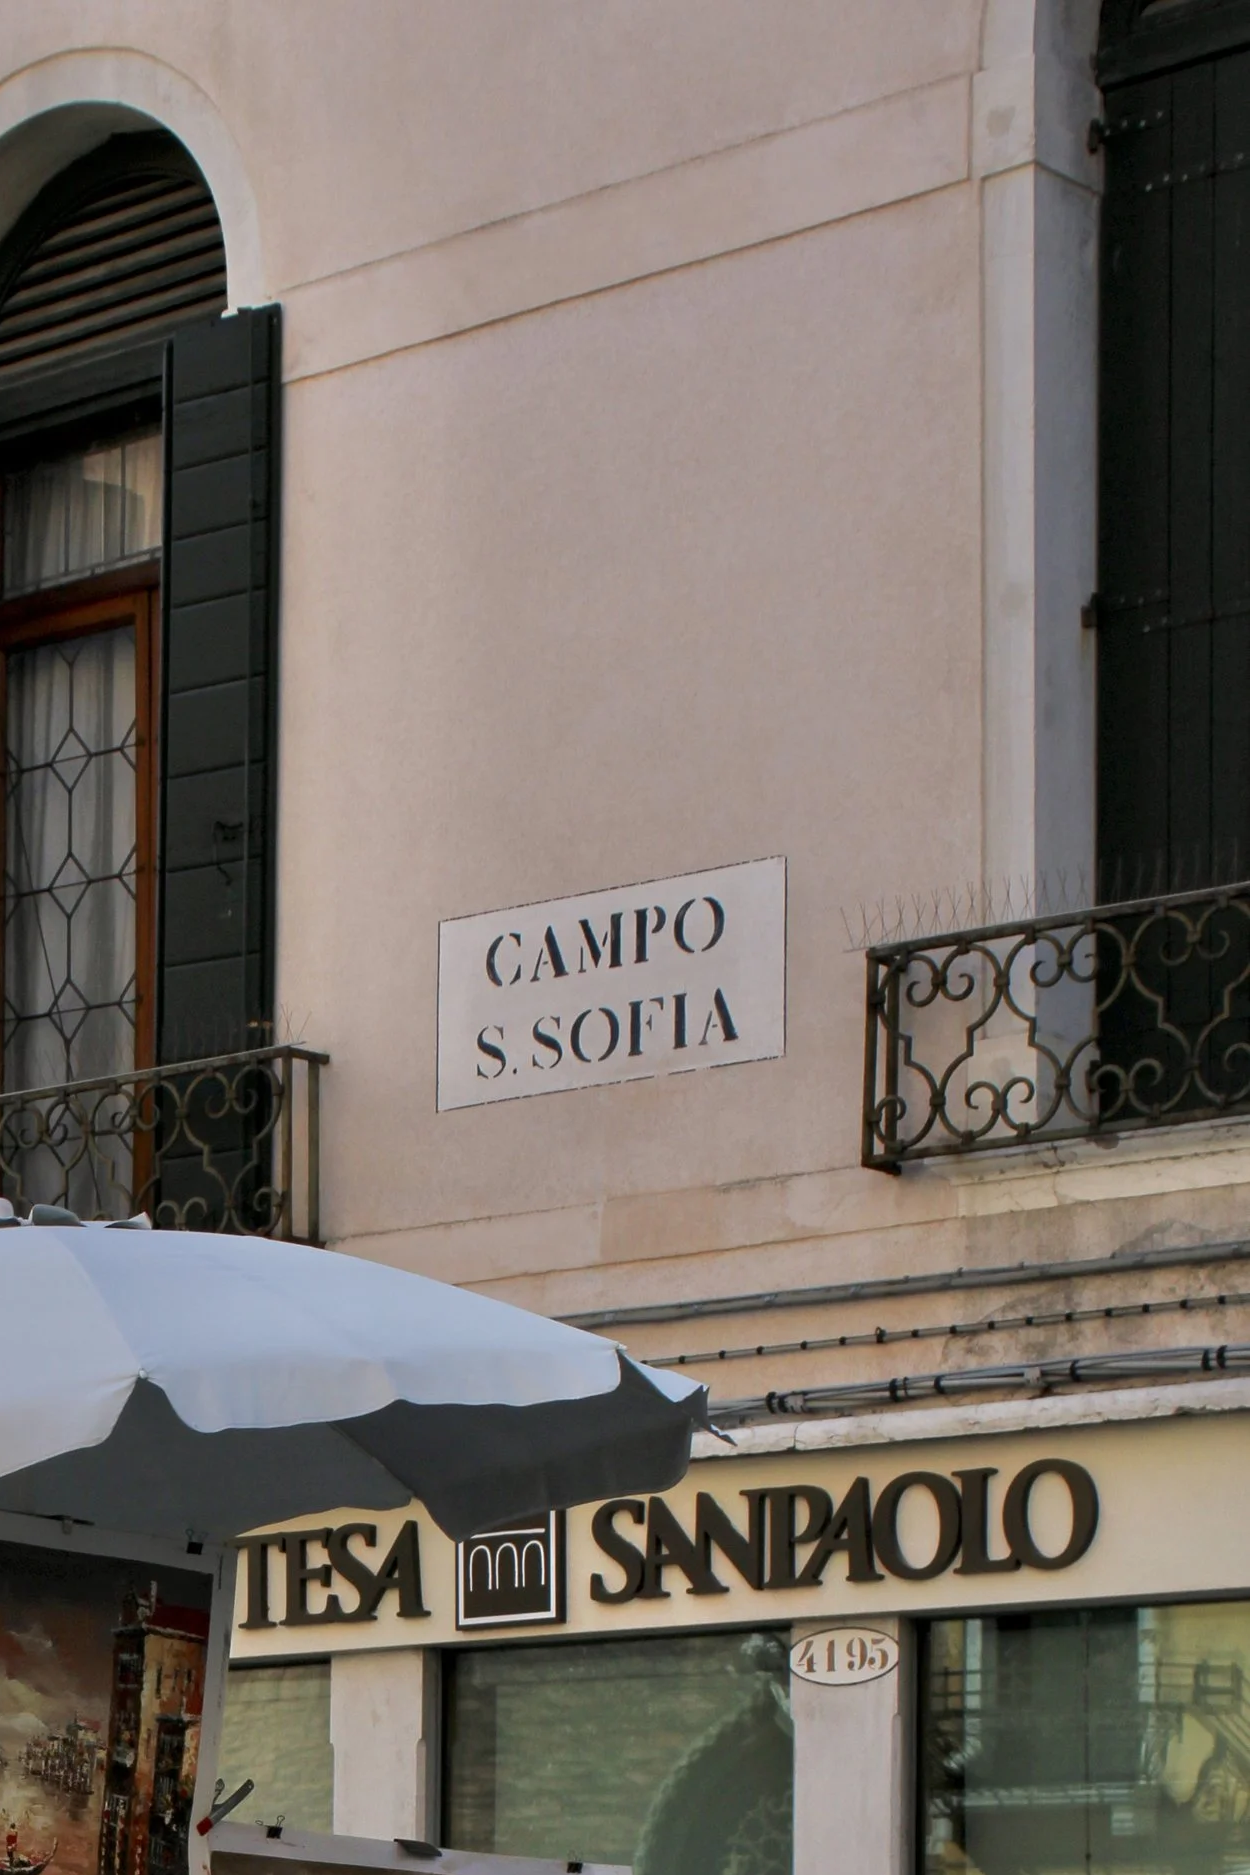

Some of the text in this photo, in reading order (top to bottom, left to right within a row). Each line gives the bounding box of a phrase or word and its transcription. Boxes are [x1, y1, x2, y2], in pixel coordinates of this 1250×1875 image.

[485, 896, 726, 988] CAMPO
[590, 1458, 1100, 1604] SANPAOLO
[796, 1635, 889, 1675] 4195
